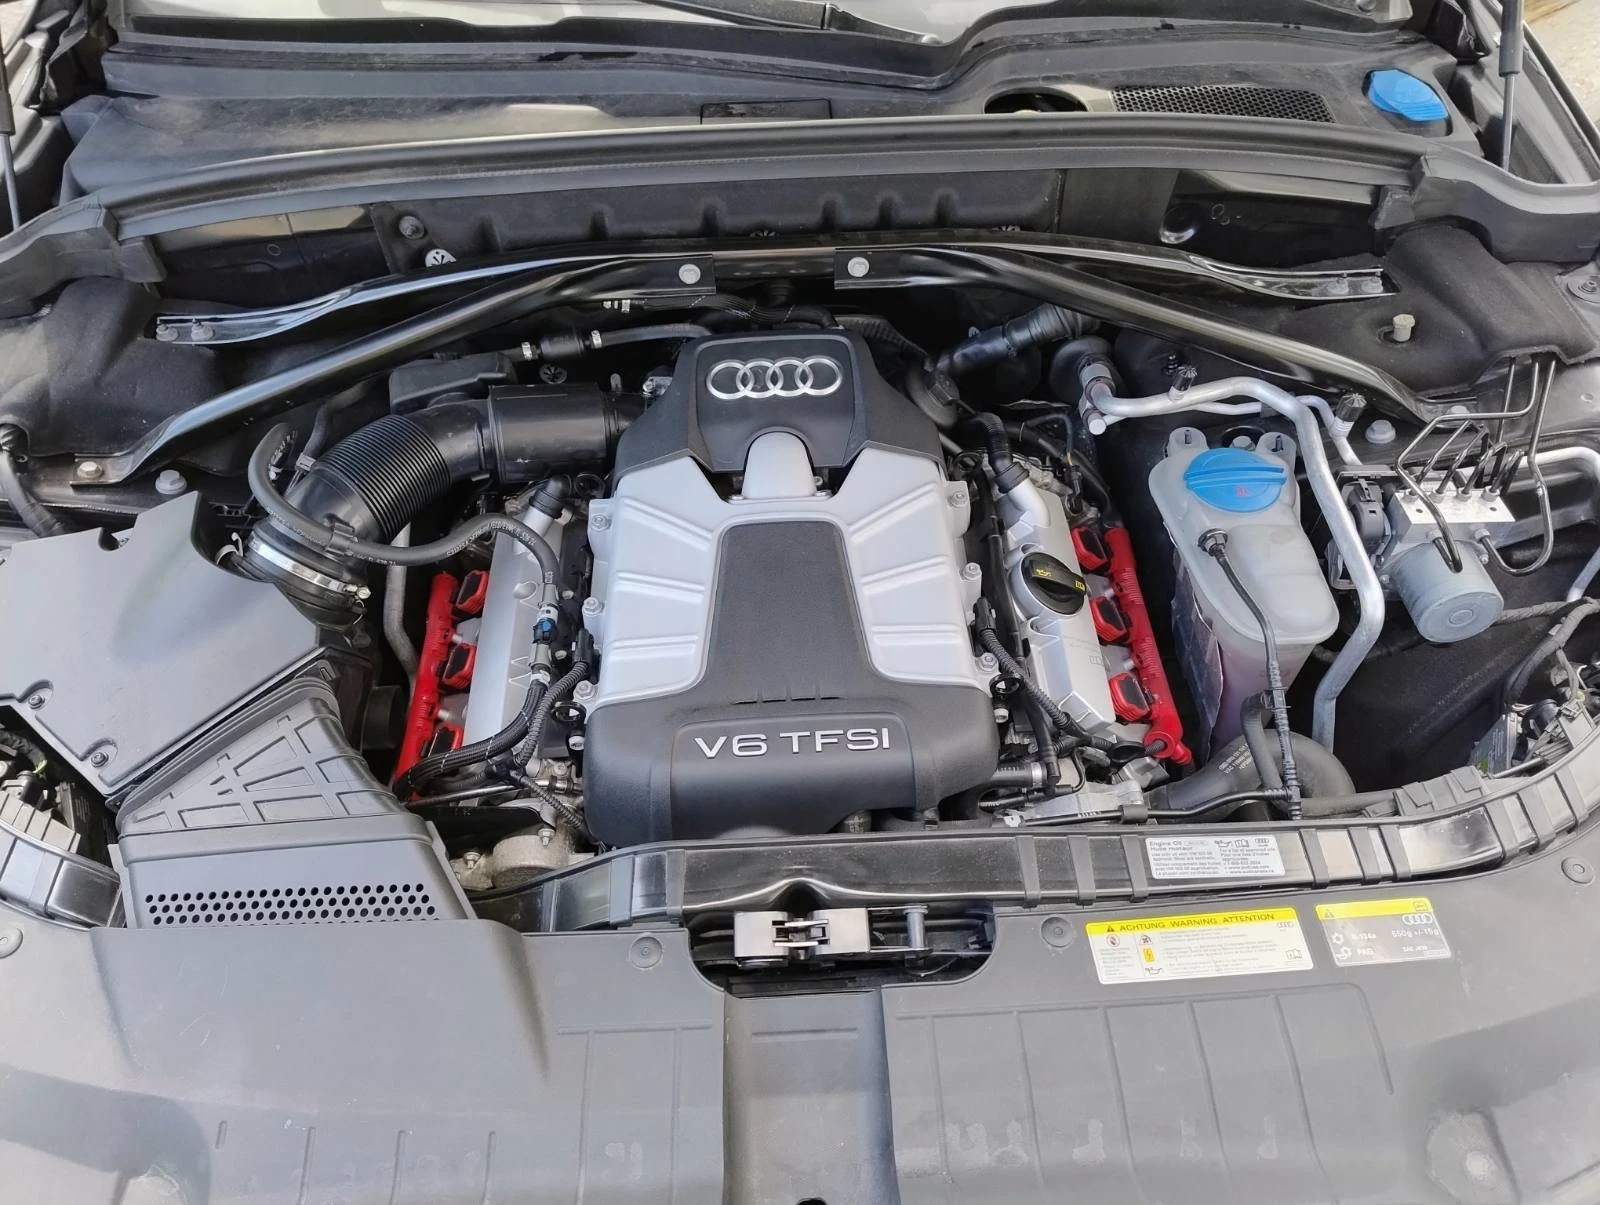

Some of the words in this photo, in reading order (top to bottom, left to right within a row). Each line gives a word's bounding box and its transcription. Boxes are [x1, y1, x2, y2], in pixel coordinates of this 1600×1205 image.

[694, 733, 768, 760] V6
[779, 727, 890, 755] TFSI
[1119, 920, 1166, 932] ACHTUNG
[1170, 917, 1218, 928] WARNING
[1222, 912, 1275, 924] ATTENTION
